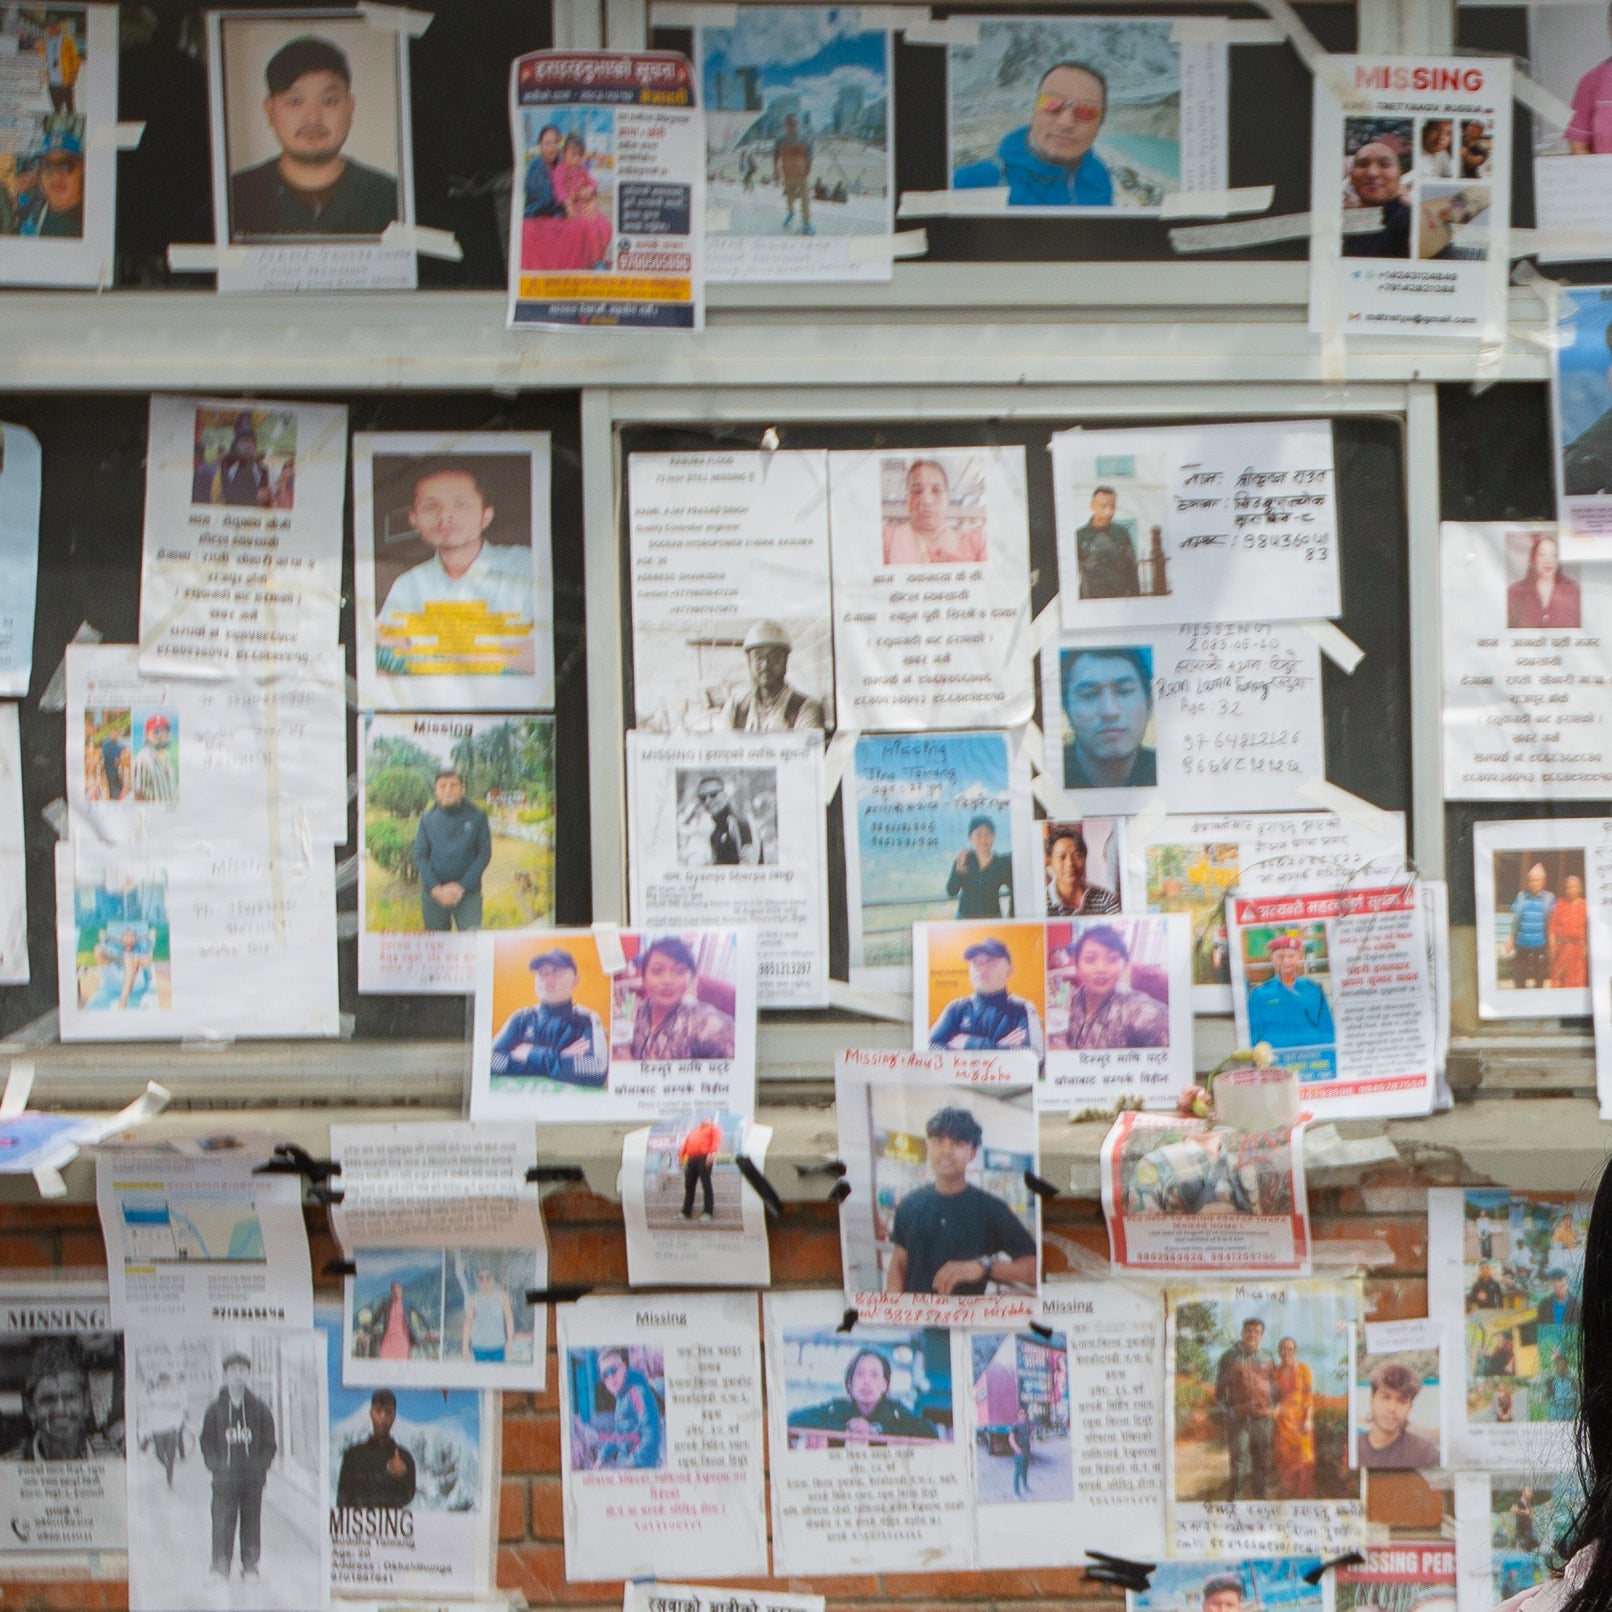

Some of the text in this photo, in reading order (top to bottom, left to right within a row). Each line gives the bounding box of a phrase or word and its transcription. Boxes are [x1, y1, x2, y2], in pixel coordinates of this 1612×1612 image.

[1354, 66, 1483, 92] MISSING
[412, 719, 474, 737] Missing
[1234, 1286, 1288, 1304] Missing
[1042, 1300, 1093, 1314] Missing
[7, 1308, 105, 1329] MISSING
[635, 1309, 688, 1327] Missing
[329, 1510, 415, 1538] MISSING
